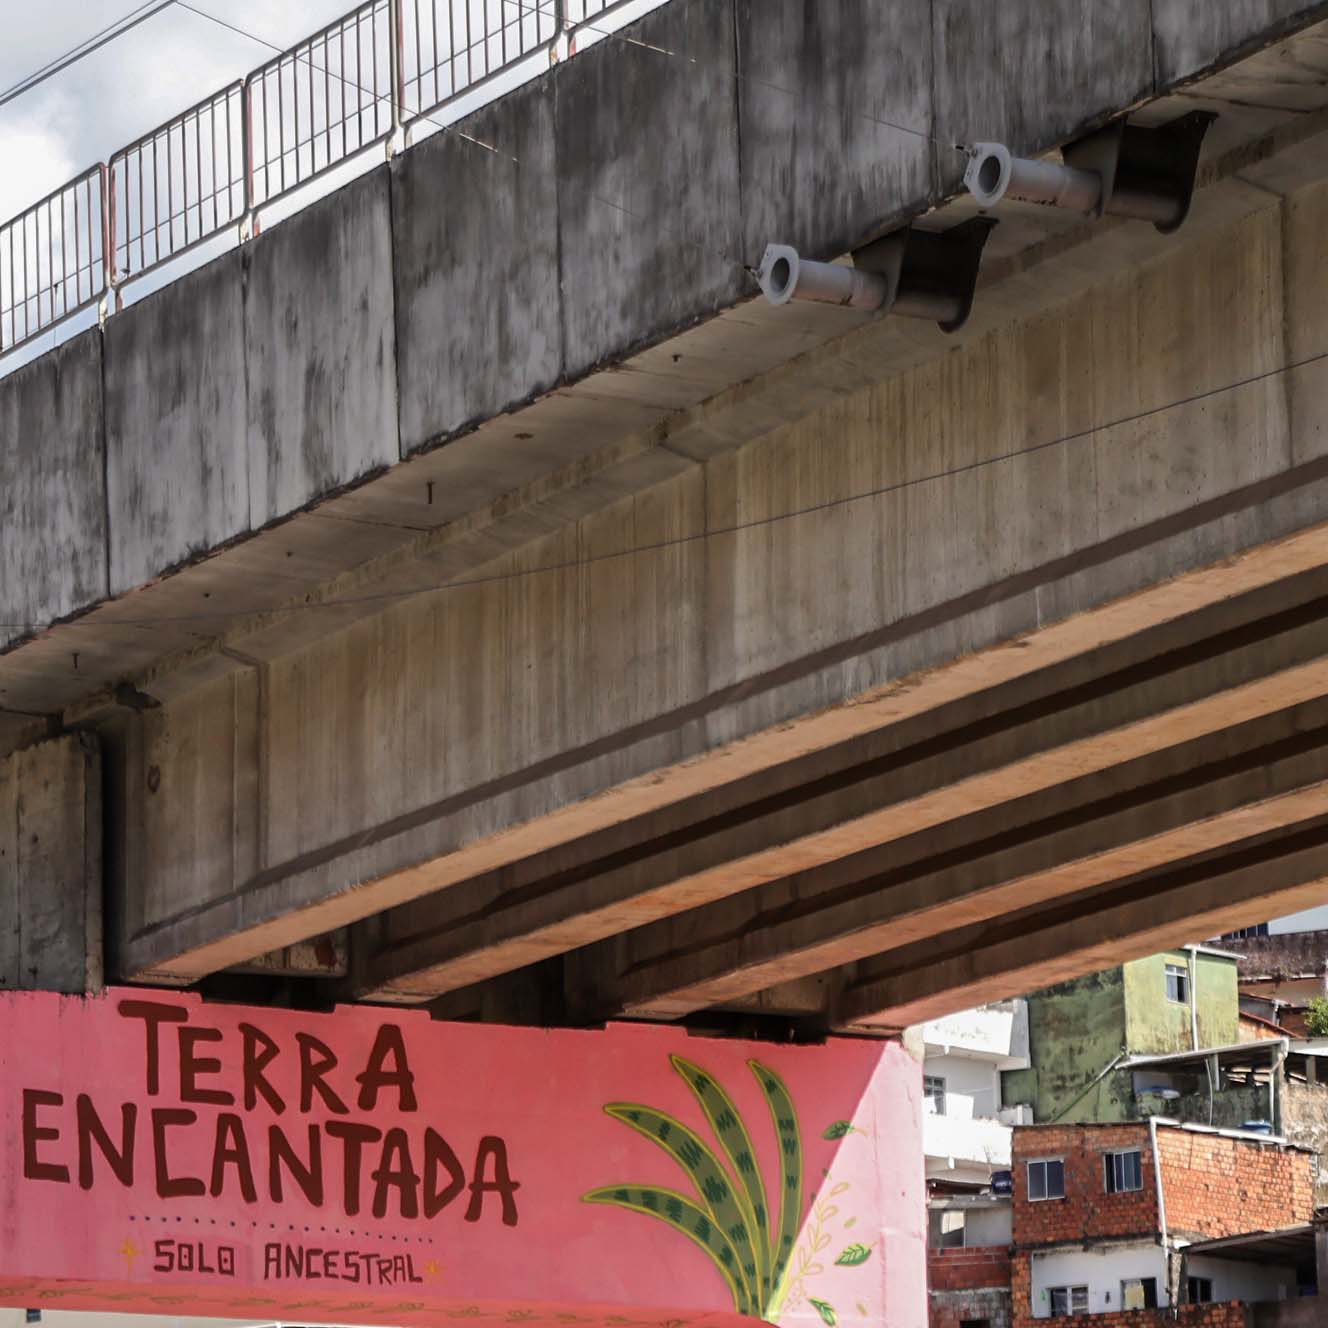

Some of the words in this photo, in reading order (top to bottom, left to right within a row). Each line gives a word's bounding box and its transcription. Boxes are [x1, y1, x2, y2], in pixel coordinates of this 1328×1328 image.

[117, 1000, 418, 1115] TERRA
[22, 1088, 520, 1227] ENCANTADA
[153, 1240, 237, 1276] SOLO
[264, 1242, 423, 1286] ANCESTRAL
